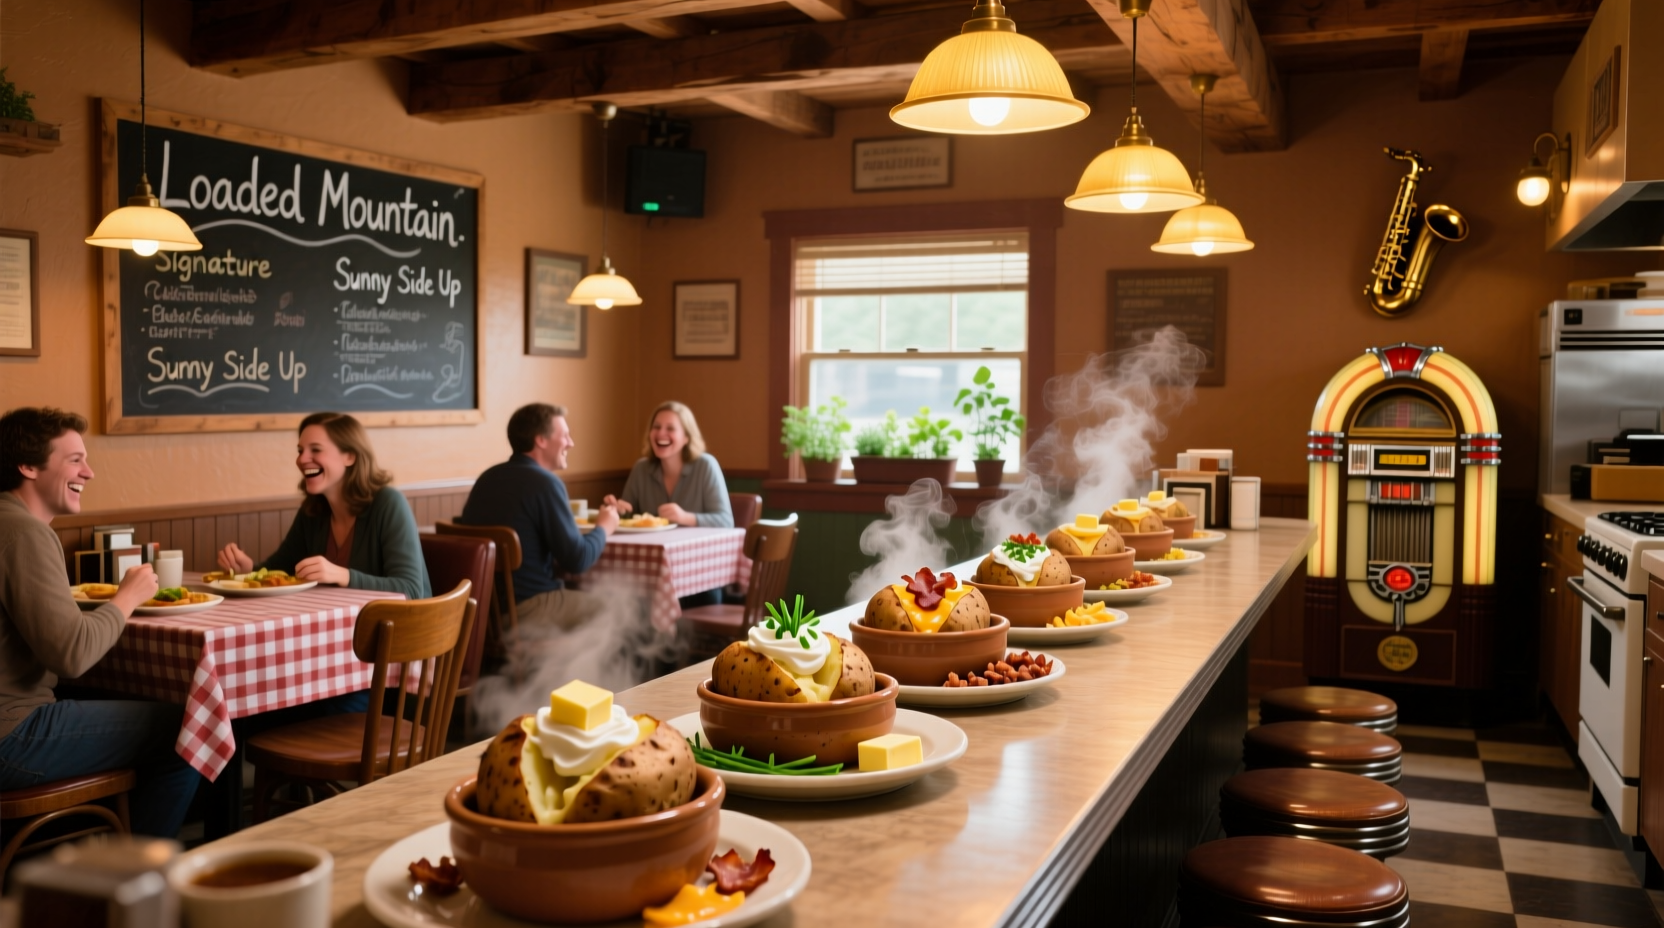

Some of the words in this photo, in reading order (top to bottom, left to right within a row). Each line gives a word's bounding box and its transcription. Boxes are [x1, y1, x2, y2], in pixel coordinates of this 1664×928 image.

[160, 140, 305, 224] Loaded
[333, 256, 392, 305] Sunny
[397, 265, 434, 296] Side
[438, 268, 462, 309] Up
[222, 347, 271, 381] Side
[278, 350, 307, 394] Up
